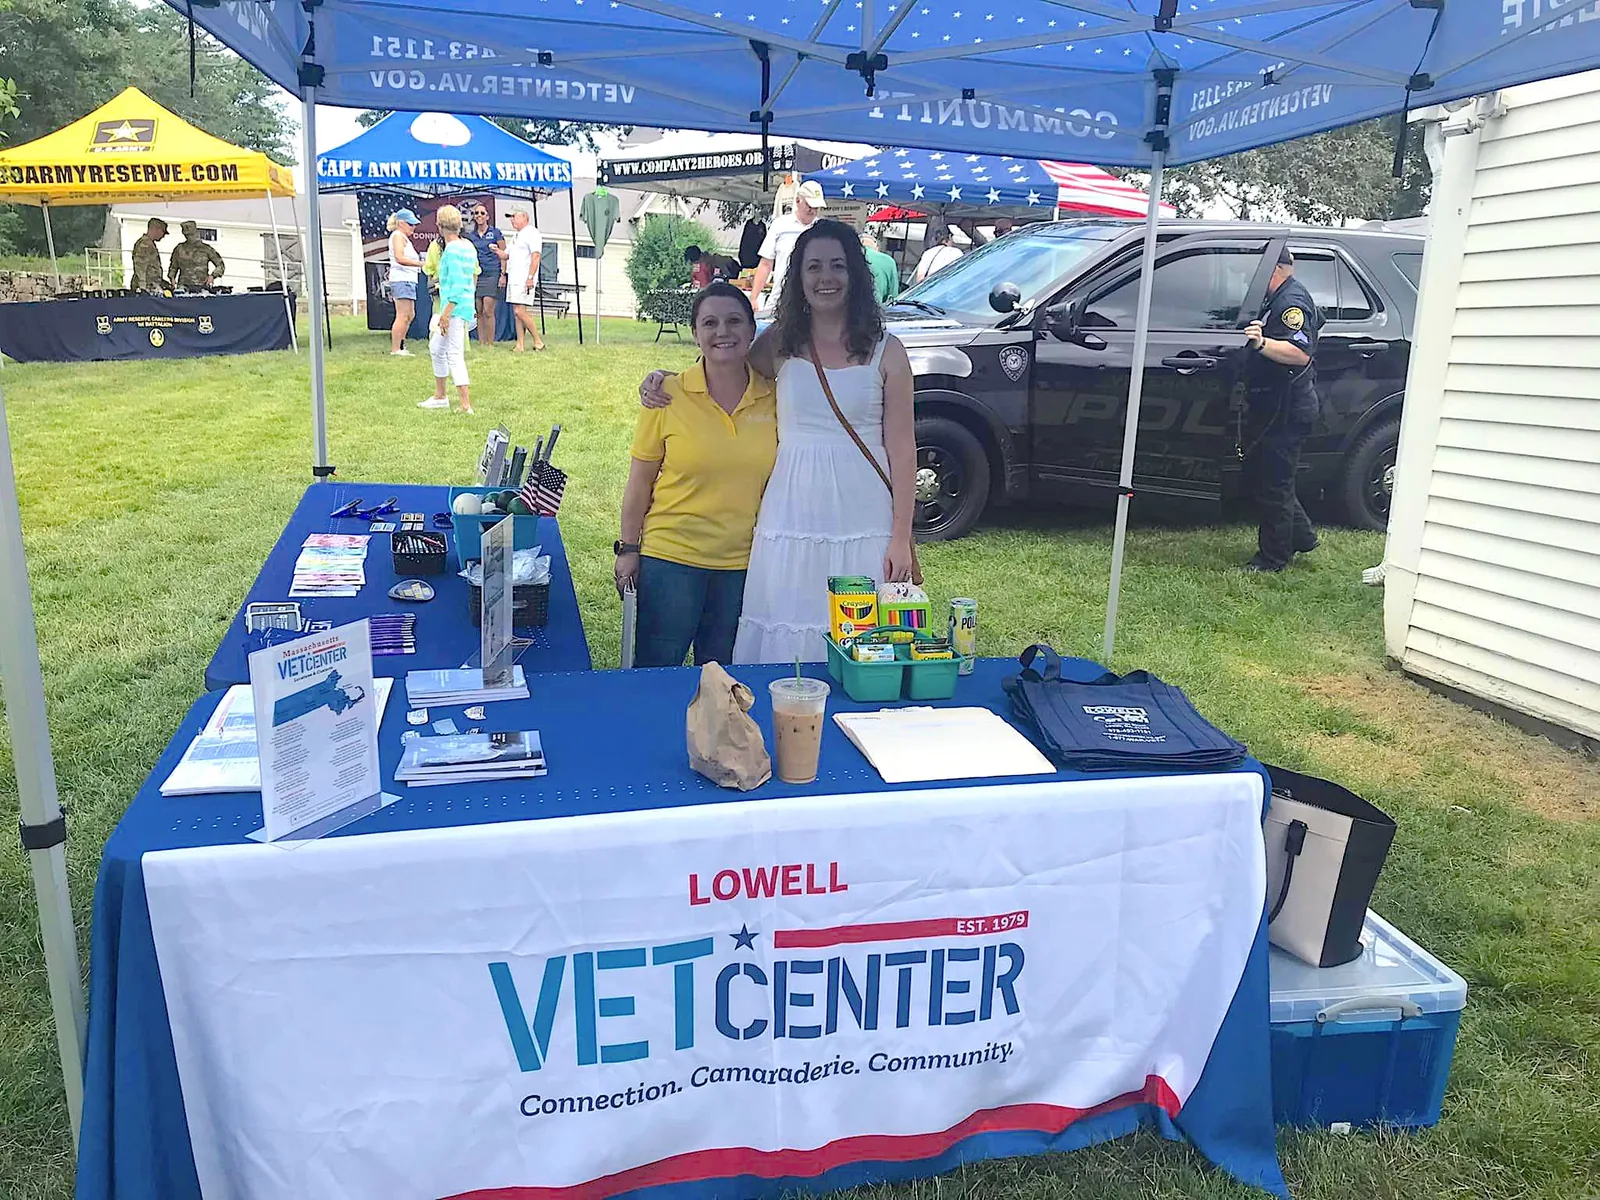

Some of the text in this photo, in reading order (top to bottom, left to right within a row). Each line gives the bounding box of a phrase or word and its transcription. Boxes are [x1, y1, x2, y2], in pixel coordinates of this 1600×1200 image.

[317, 157, 571, 183] CAPE ANN VETERANS SERVICES
[1064, 393, 1227, 436] POL
[842, 600, 870, 608] Crayola
[282, 635, 340, 659] Massachusetts
[688, 861, 849, 906] LOWELL
[956, 912, 1026, 934] EST. 1979
[520, 1040, 1015, 1117] Connection. Camaraderie. Community.
